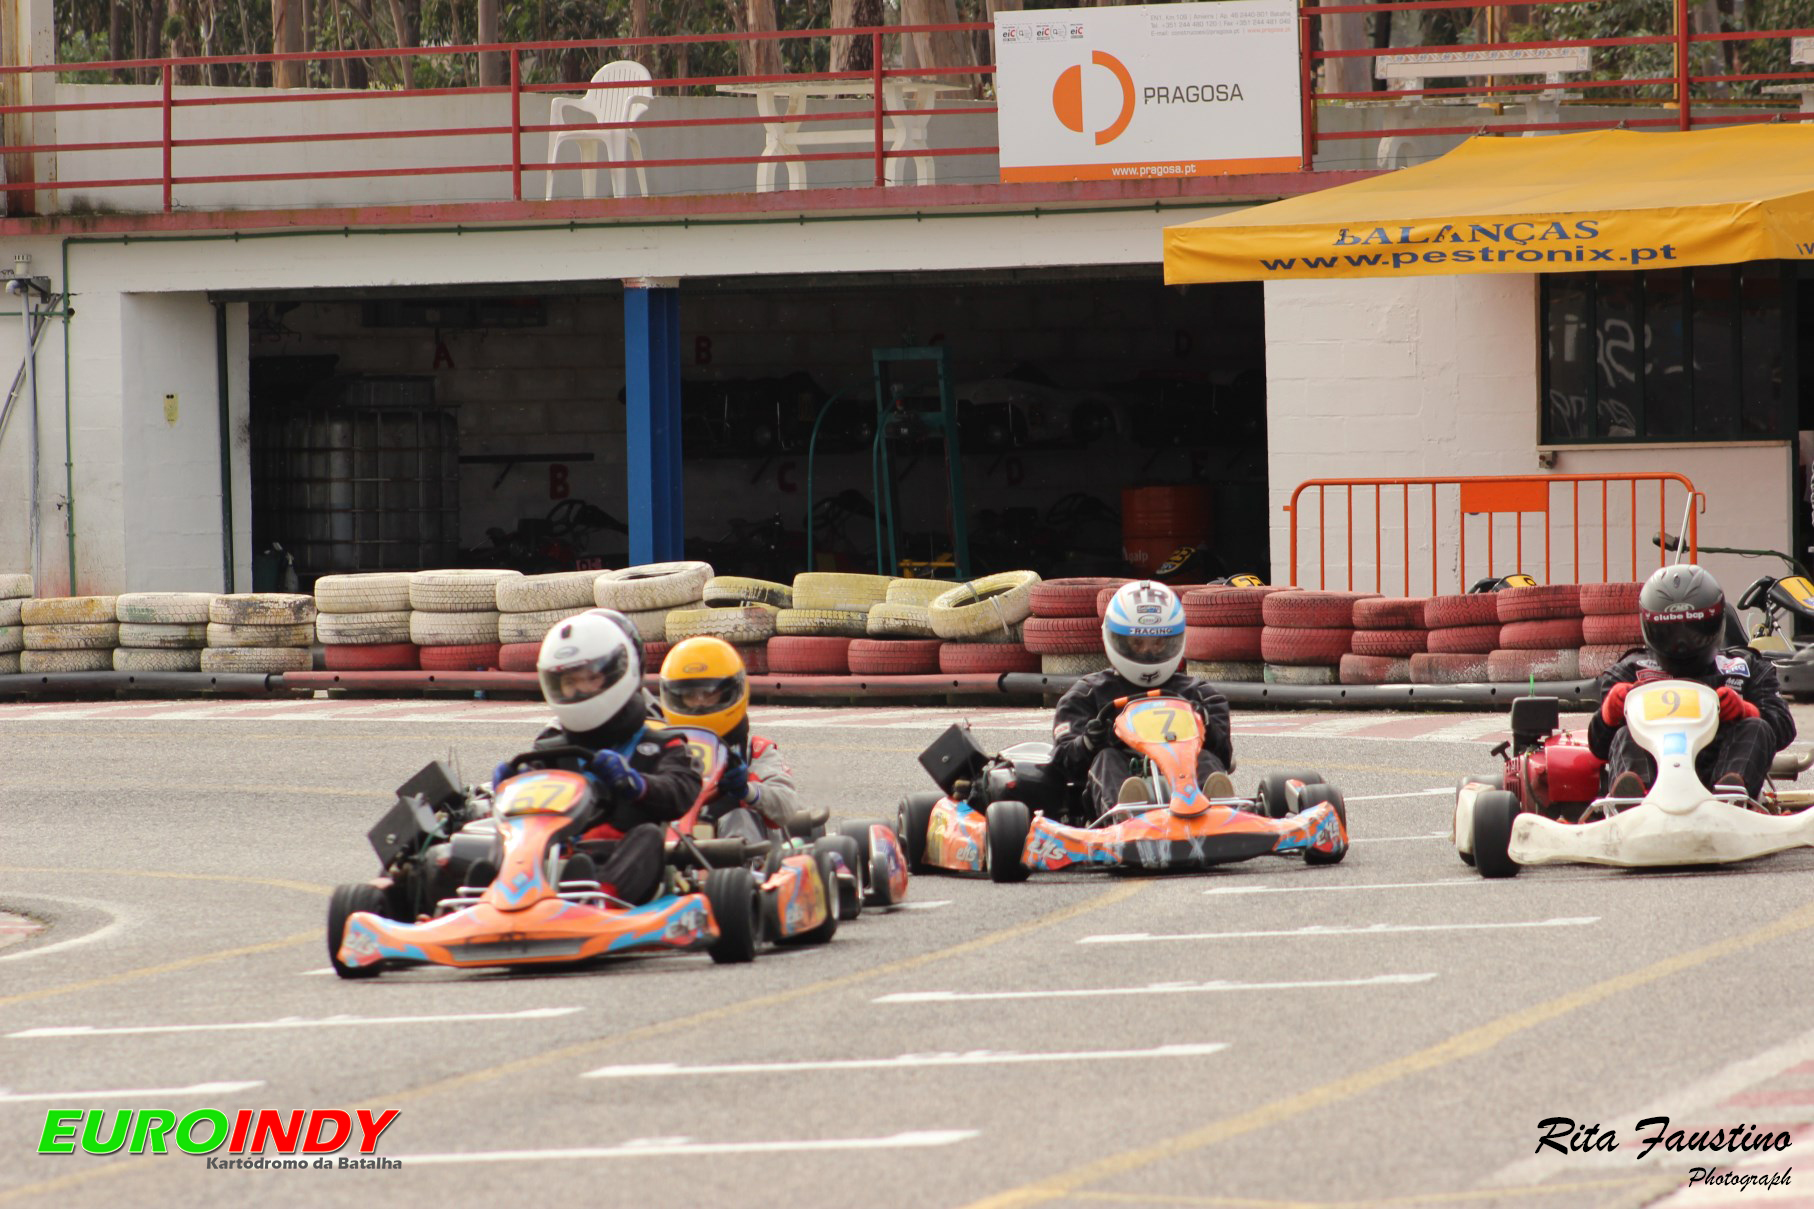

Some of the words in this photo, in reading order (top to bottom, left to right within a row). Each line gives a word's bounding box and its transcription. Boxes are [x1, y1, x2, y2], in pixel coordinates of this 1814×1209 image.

[1144, 83, 1243, 105] PRAGOSA
[1111, 163, 1196, 177] www.pragosa.pt
[1260, 243, 1677, 270] www.pestronix.pt
[433, 341, 455, 368] A
[695, 335, 711, 365] B
[549, 464, 569, 500] B
[777, 462, 797, 492] C
[1128, 549, 1148, 564] galp
[1127, 588, 1169, 607] TR
[1653, 613, 1683, 621] clube
[1686, 611, 1704, 620] bcp
[1661, 690, 1681, 717] 9
[1153, 710, 1176, 735] 7
